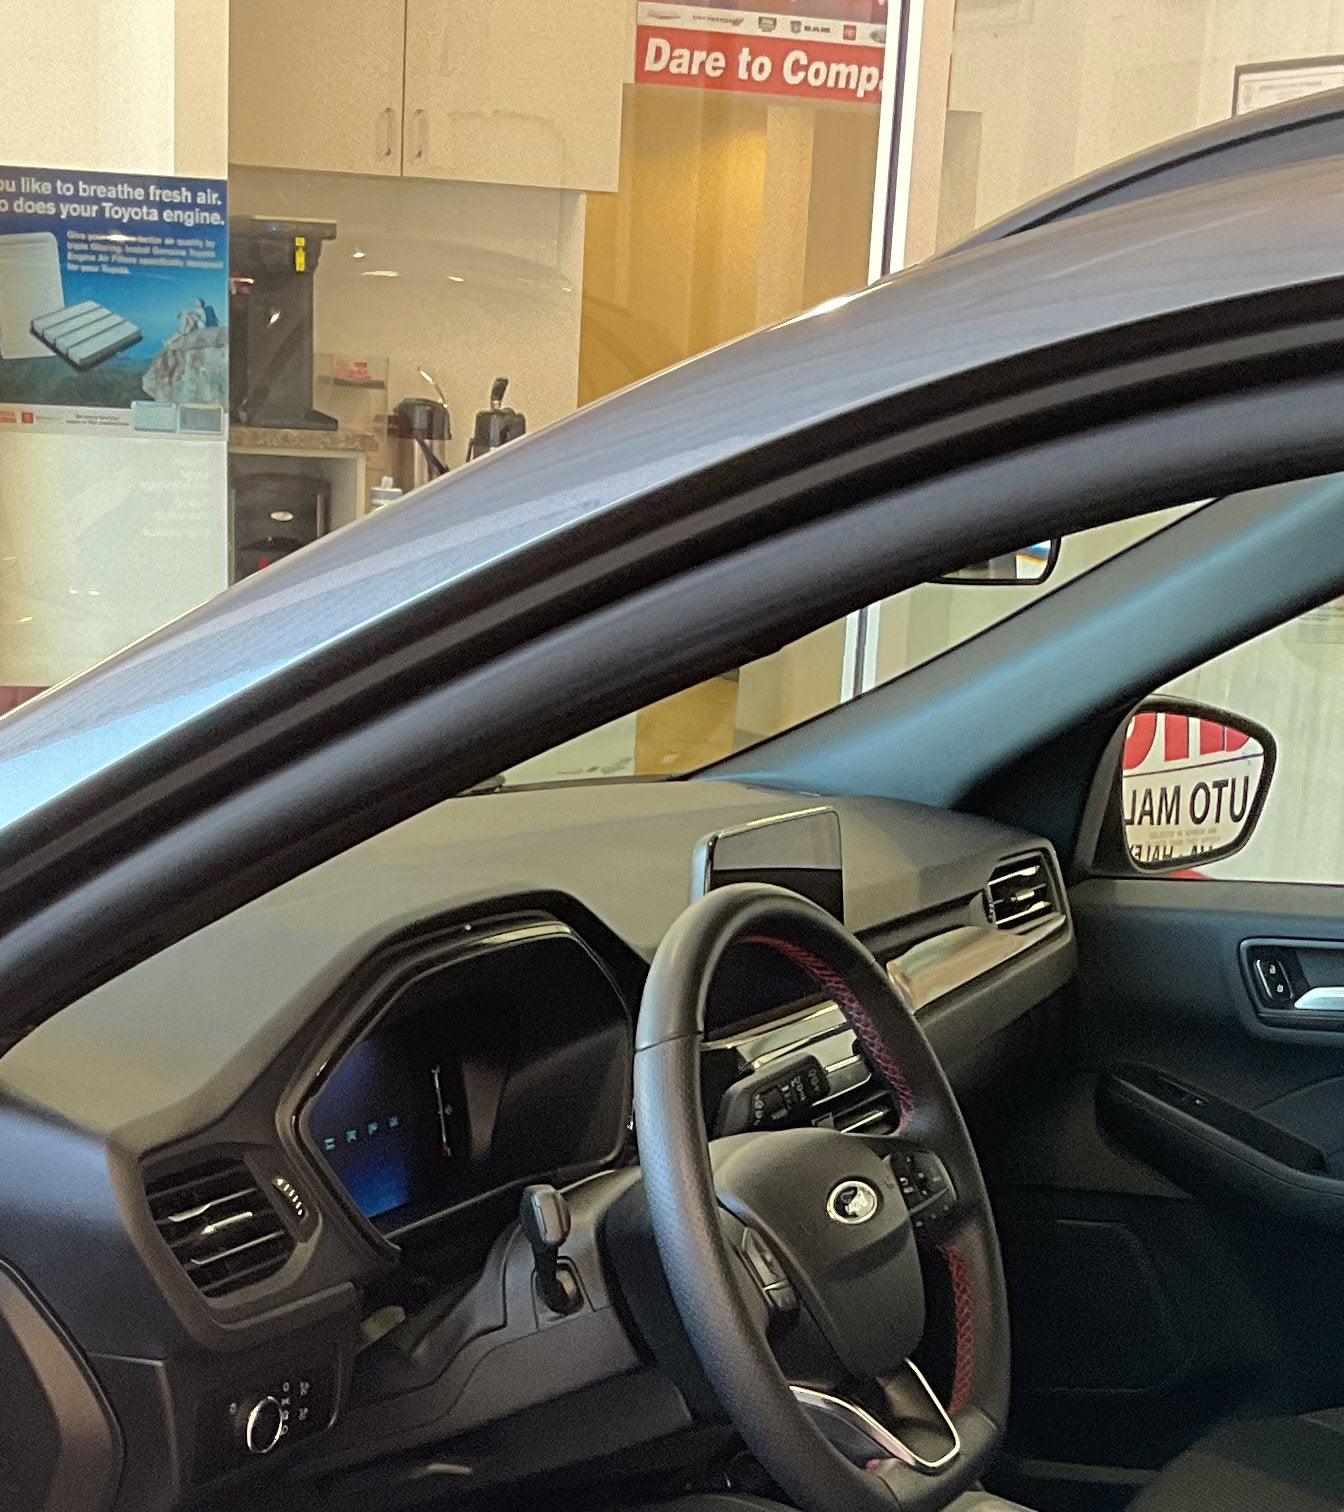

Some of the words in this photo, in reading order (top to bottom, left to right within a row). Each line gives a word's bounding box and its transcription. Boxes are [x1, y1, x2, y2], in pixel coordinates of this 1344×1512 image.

[644, 37, 726, 77] Dare
[737, 47, 772, 81] to
[783, 50, 884, 98] Comp
[21, 176, 53, 194] like
[56, 179, 74, 196] to
[78, 180, 145, 200] breathe
[148, 185, 192, 203] fresh
[196, 188, 223, 206] air.
[13, 196, 56, 215] does
[59, 202, 99, 219] your
[101, 202, 159, 223] Toyota
[163, 207, 225, 227] engine.
